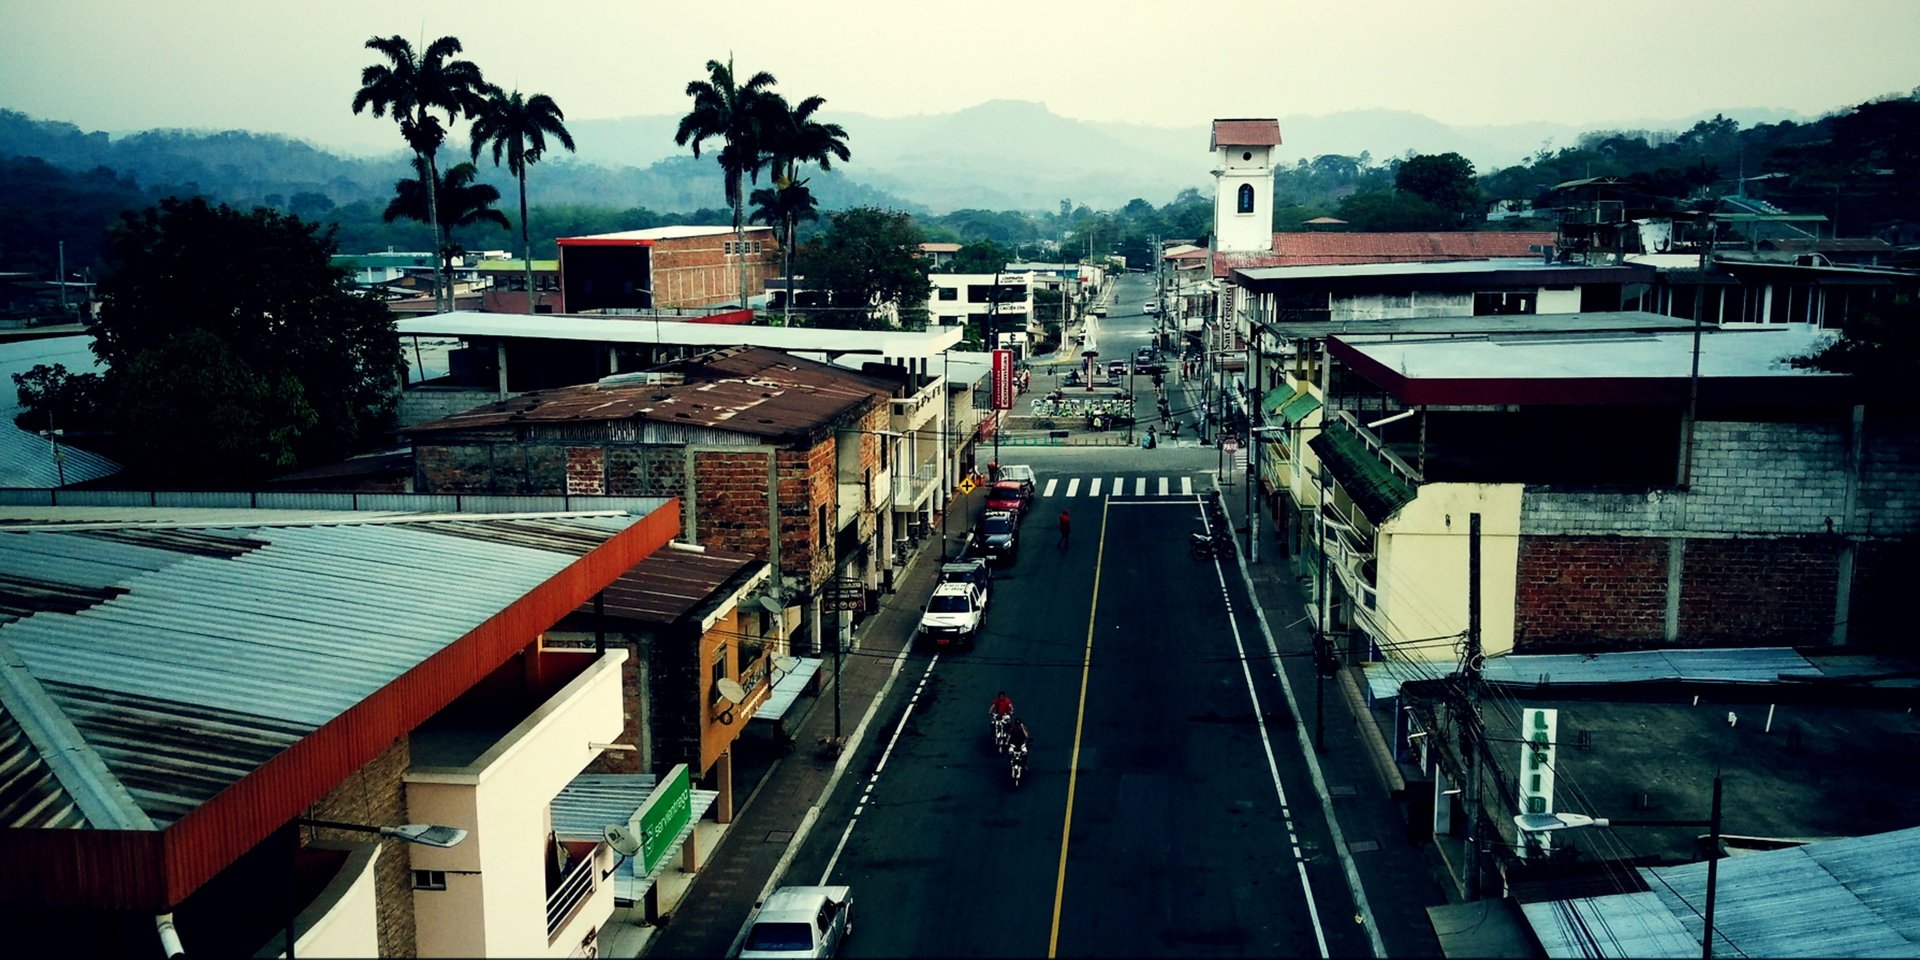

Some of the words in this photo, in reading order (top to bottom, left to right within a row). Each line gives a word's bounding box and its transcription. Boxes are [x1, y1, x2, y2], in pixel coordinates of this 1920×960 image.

[1223, 288, 1233, 330] Gregorio
[1223, 332, 1231, 350] San
[1528, 710, 1551, 846] LAPID
[654, 788, 689, 838] servientrega
